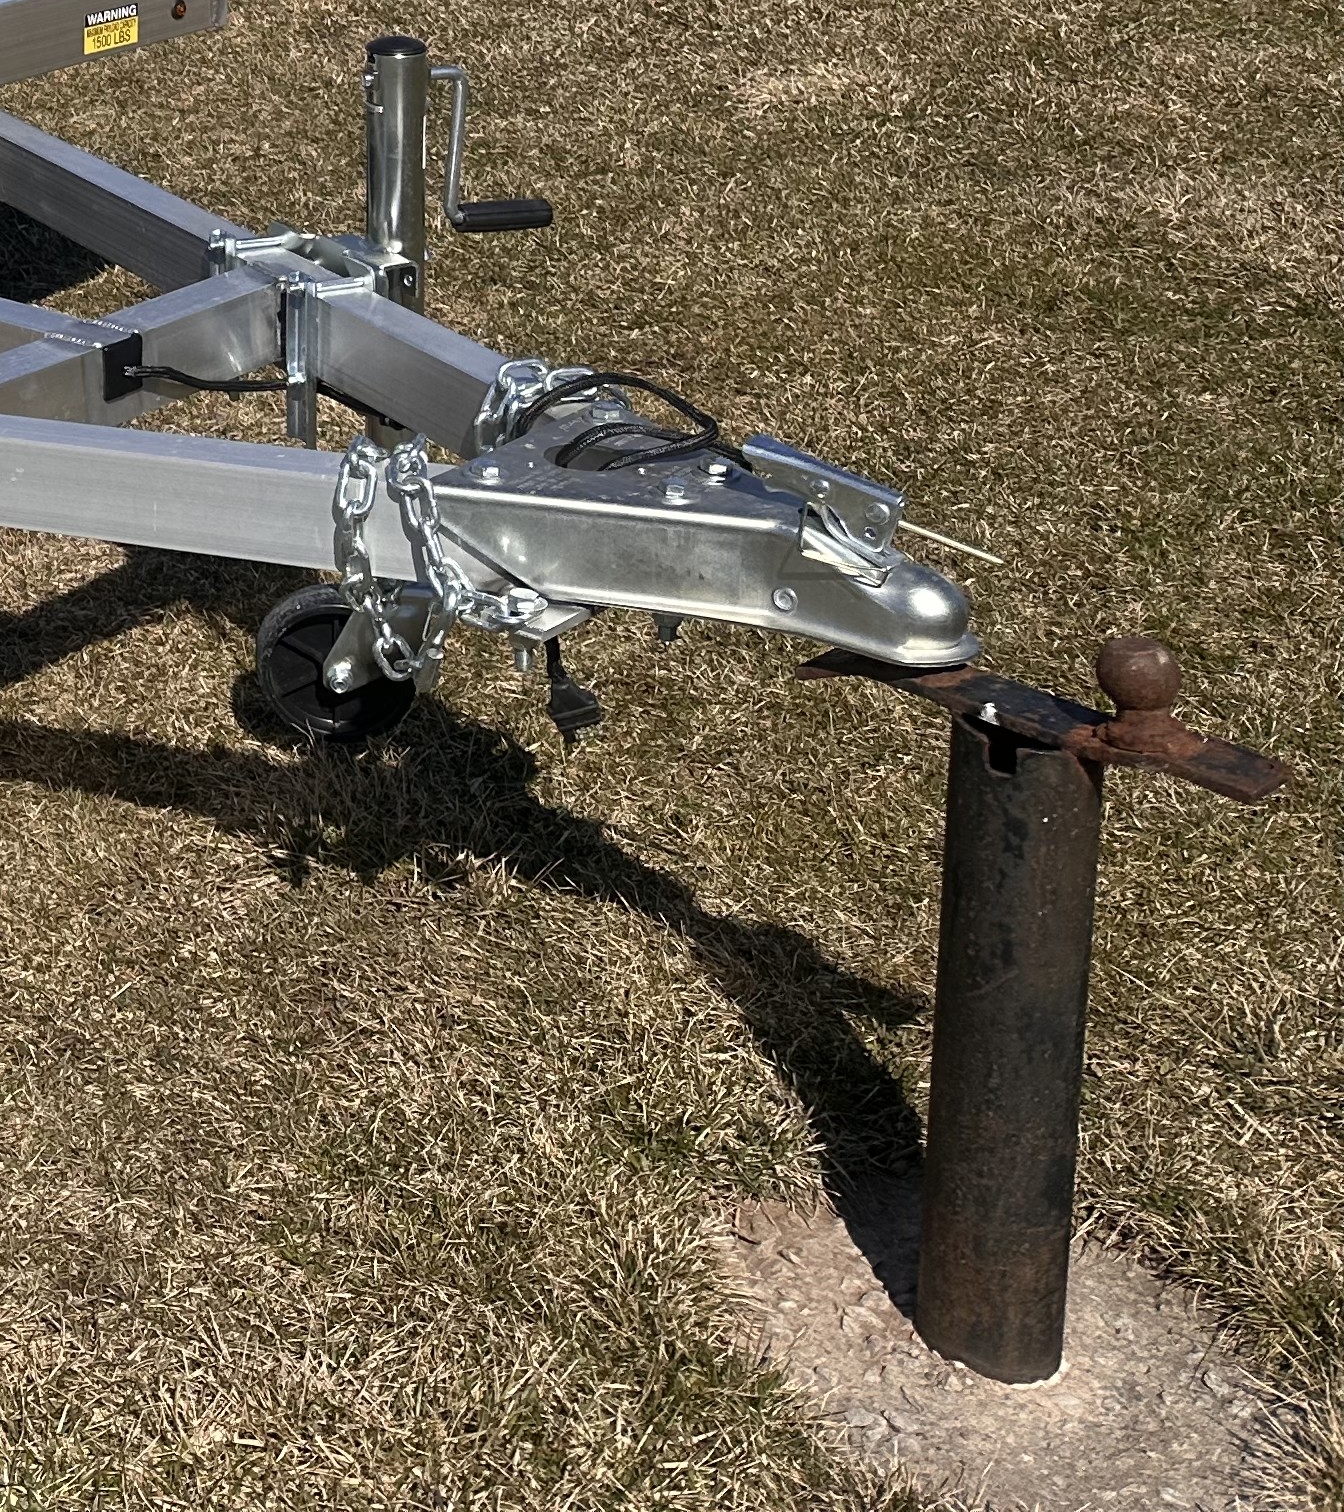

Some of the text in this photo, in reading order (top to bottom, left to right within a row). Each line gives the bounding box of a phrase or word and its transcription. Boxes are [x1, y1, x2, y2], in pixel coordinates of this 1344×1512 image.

[87, 4, 137, 26] WARNING
[92, 34, 112, 49] 1500
[114, 29, 131, 44] LBS
